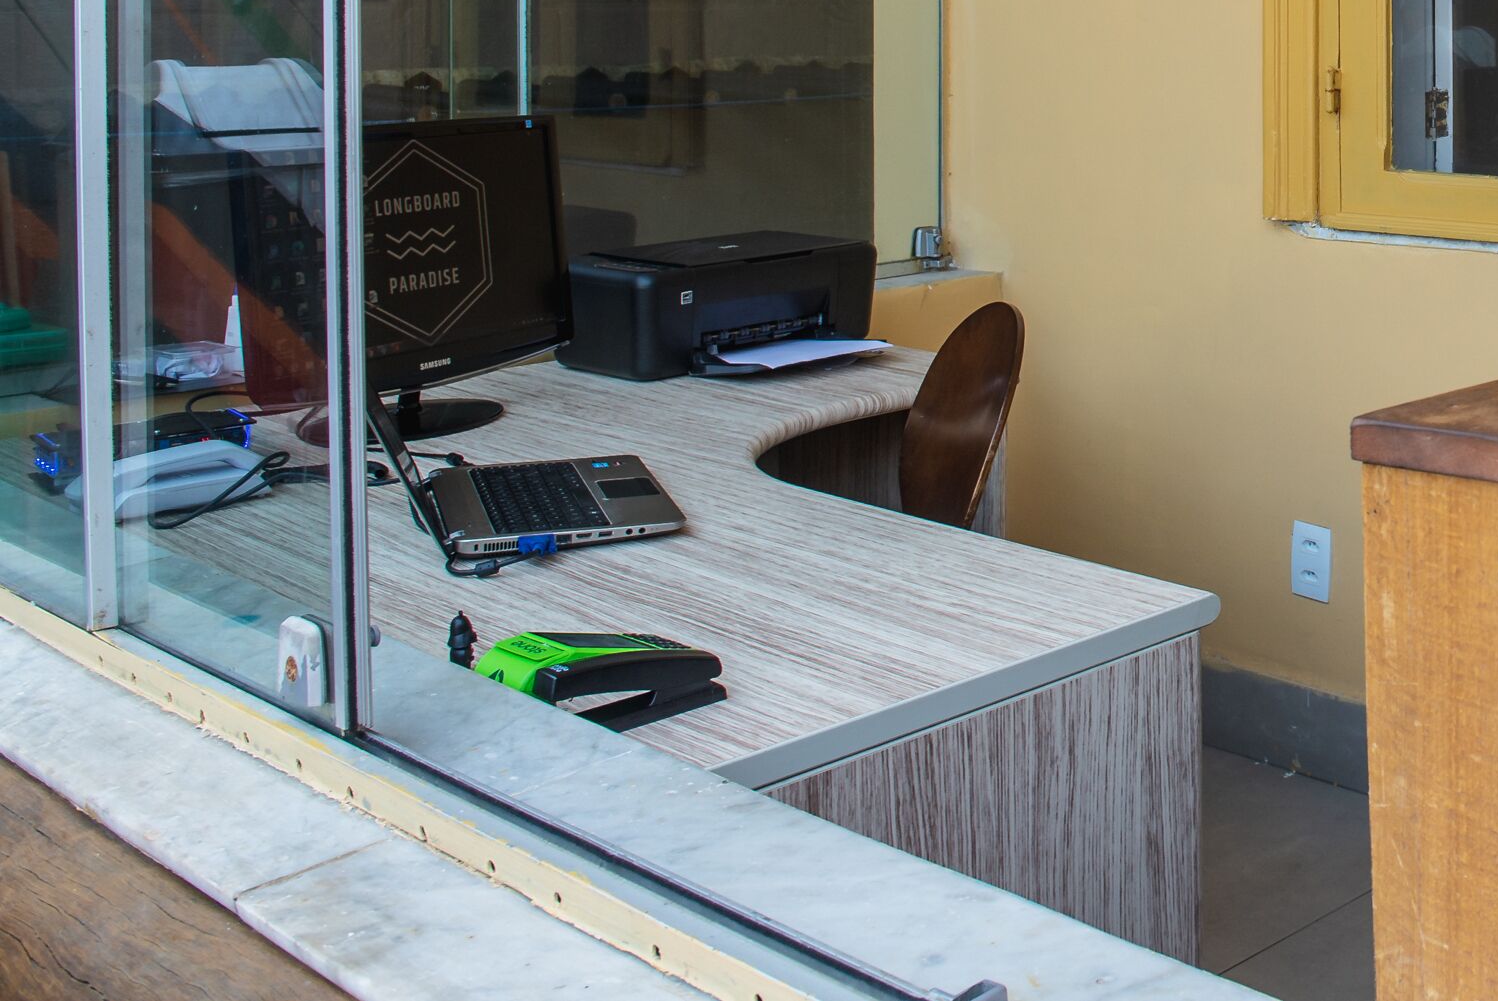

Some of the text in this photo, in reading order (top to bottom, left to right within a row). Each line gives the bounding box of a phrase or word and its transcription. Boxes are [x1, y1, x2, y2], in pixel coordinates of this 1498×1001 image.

[375, 191, 461, 217] LONGBOARD
[389, 267, 461, 294] PARADISE
[419, 358, 452, 371] SAMSUNG
